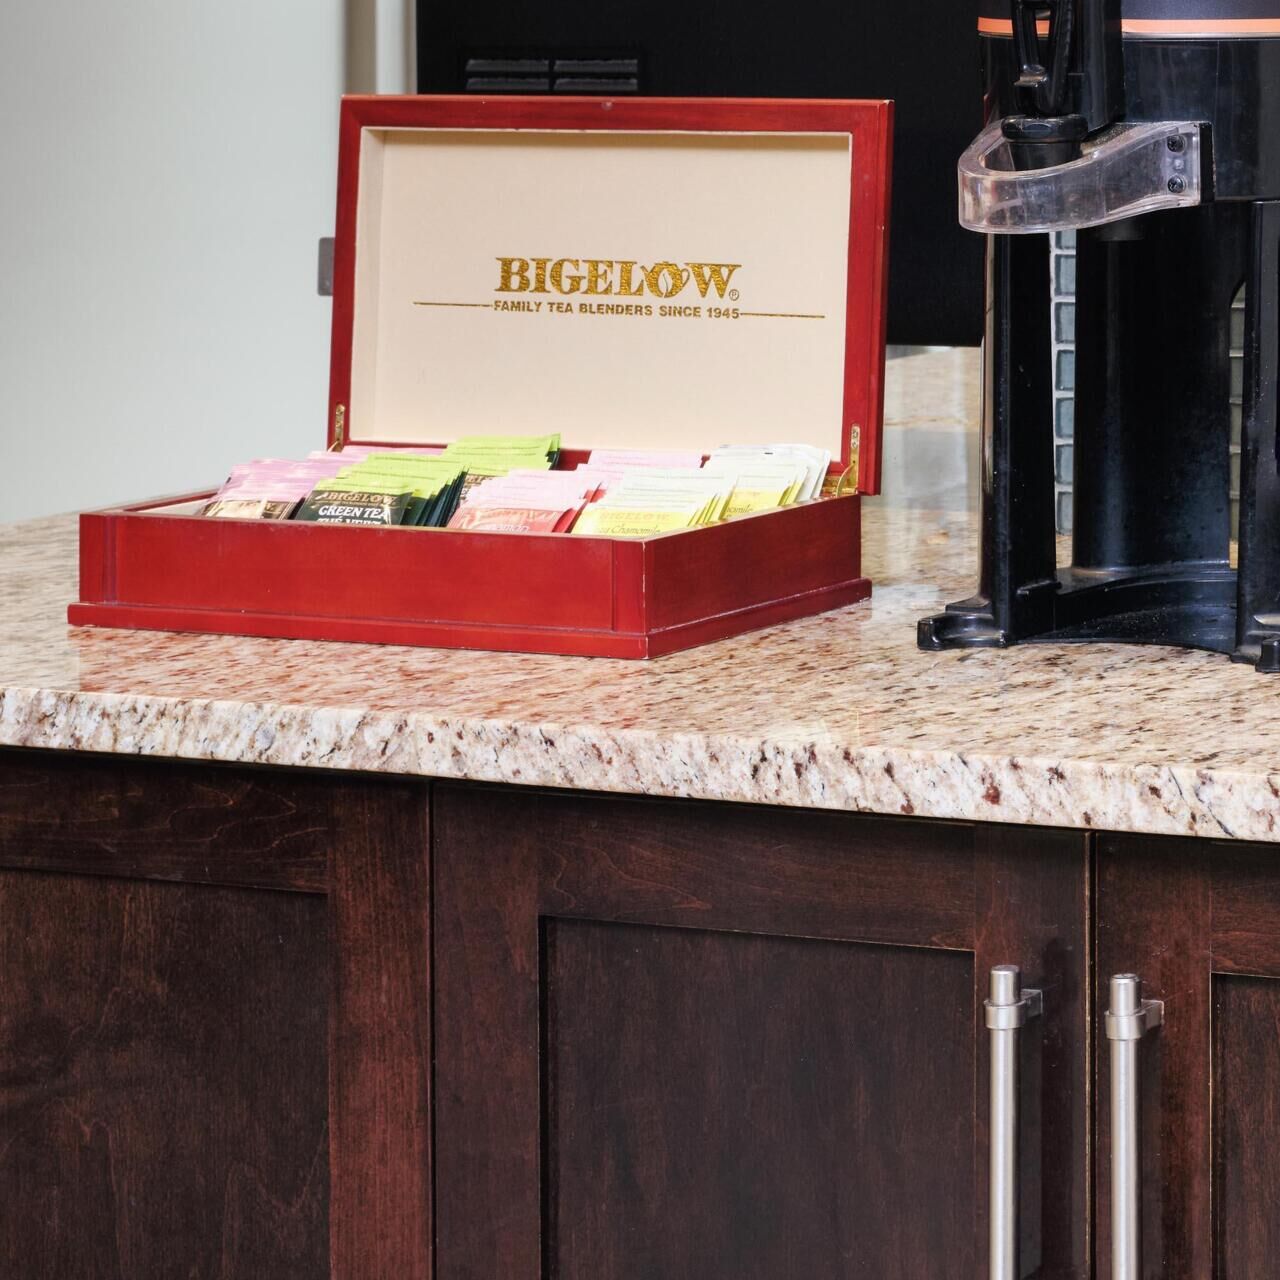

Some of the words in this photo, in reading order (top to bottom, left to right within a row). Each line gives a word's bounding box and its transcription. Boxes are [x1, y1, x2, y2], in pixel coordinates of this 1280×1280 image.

[494, 257, 742, 299] BIGELOW
[494, 300, 541, 312] FAMILY
[549, 302, 573, 313] TEA
[579, 303, 652, 316] BLENDERS
[659, 305, 700, 317] SINCE
[706, 307, 740, 319] 1945
[319, 506, 362, 518] GREEN
[363, 507, 391, 518] TEA
